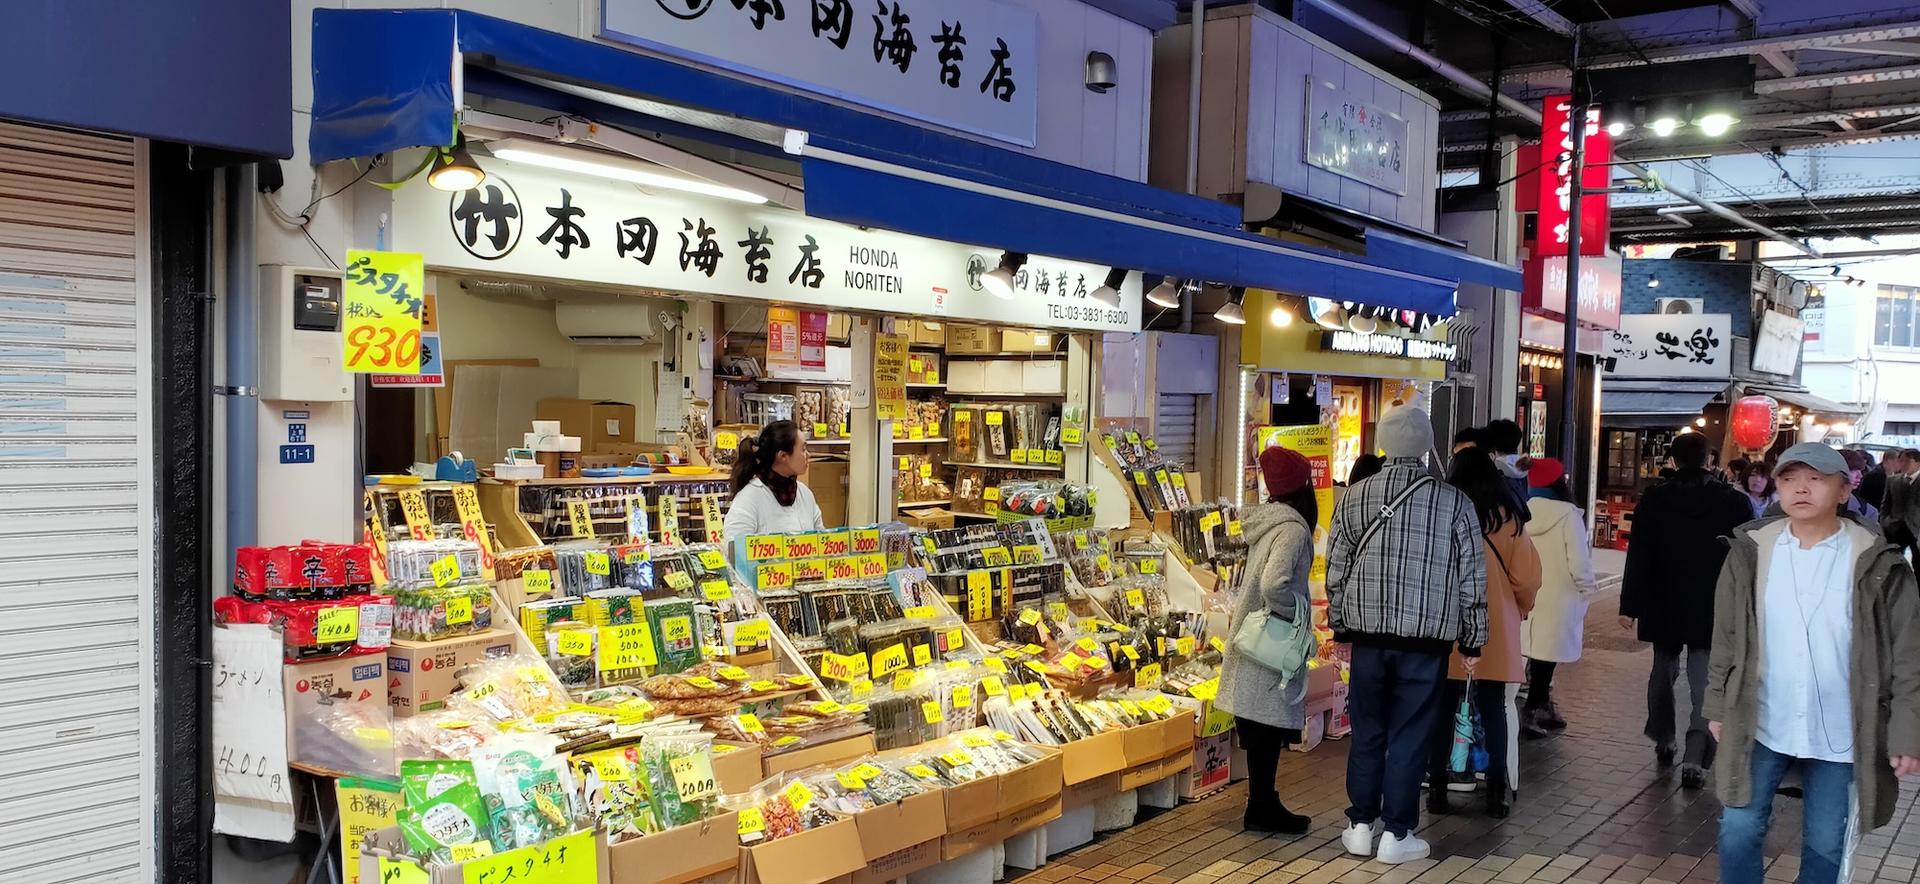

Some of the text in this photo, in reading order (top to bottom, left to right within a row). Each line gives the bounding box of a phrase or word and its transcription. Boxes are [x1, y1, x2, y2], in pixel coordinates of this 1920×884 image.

[849, 244, 899, 270] HONDA
[345, 257, 422, 320] ピスタチオ
[844, 269, 903, 294] NORITEN
[1048, 303, 1129, 325] TEL:03-3831-6300
[346, 325, 422, 369] 930
[285, 448, 310, 460] 11-1
[753, 543, 781, 559] 1750円
[788, 543, 817, 558] 2000円
[823, 541, 848, 555] 2500円
[855, 538, 878, 551] 3000円
[303, 555, 326, 592] 辛
[832, 564, 856, 579] 500円
[863, 562, 884, 576] 600円
[765, 572, 790, 586] 350円
[435, 655, 456, 669] 농심
[216, 664, 265, 687] ラーメン
[349, 794, 397, 819] お客様へ
[479, 845, 569, 884] ピスタチオ
